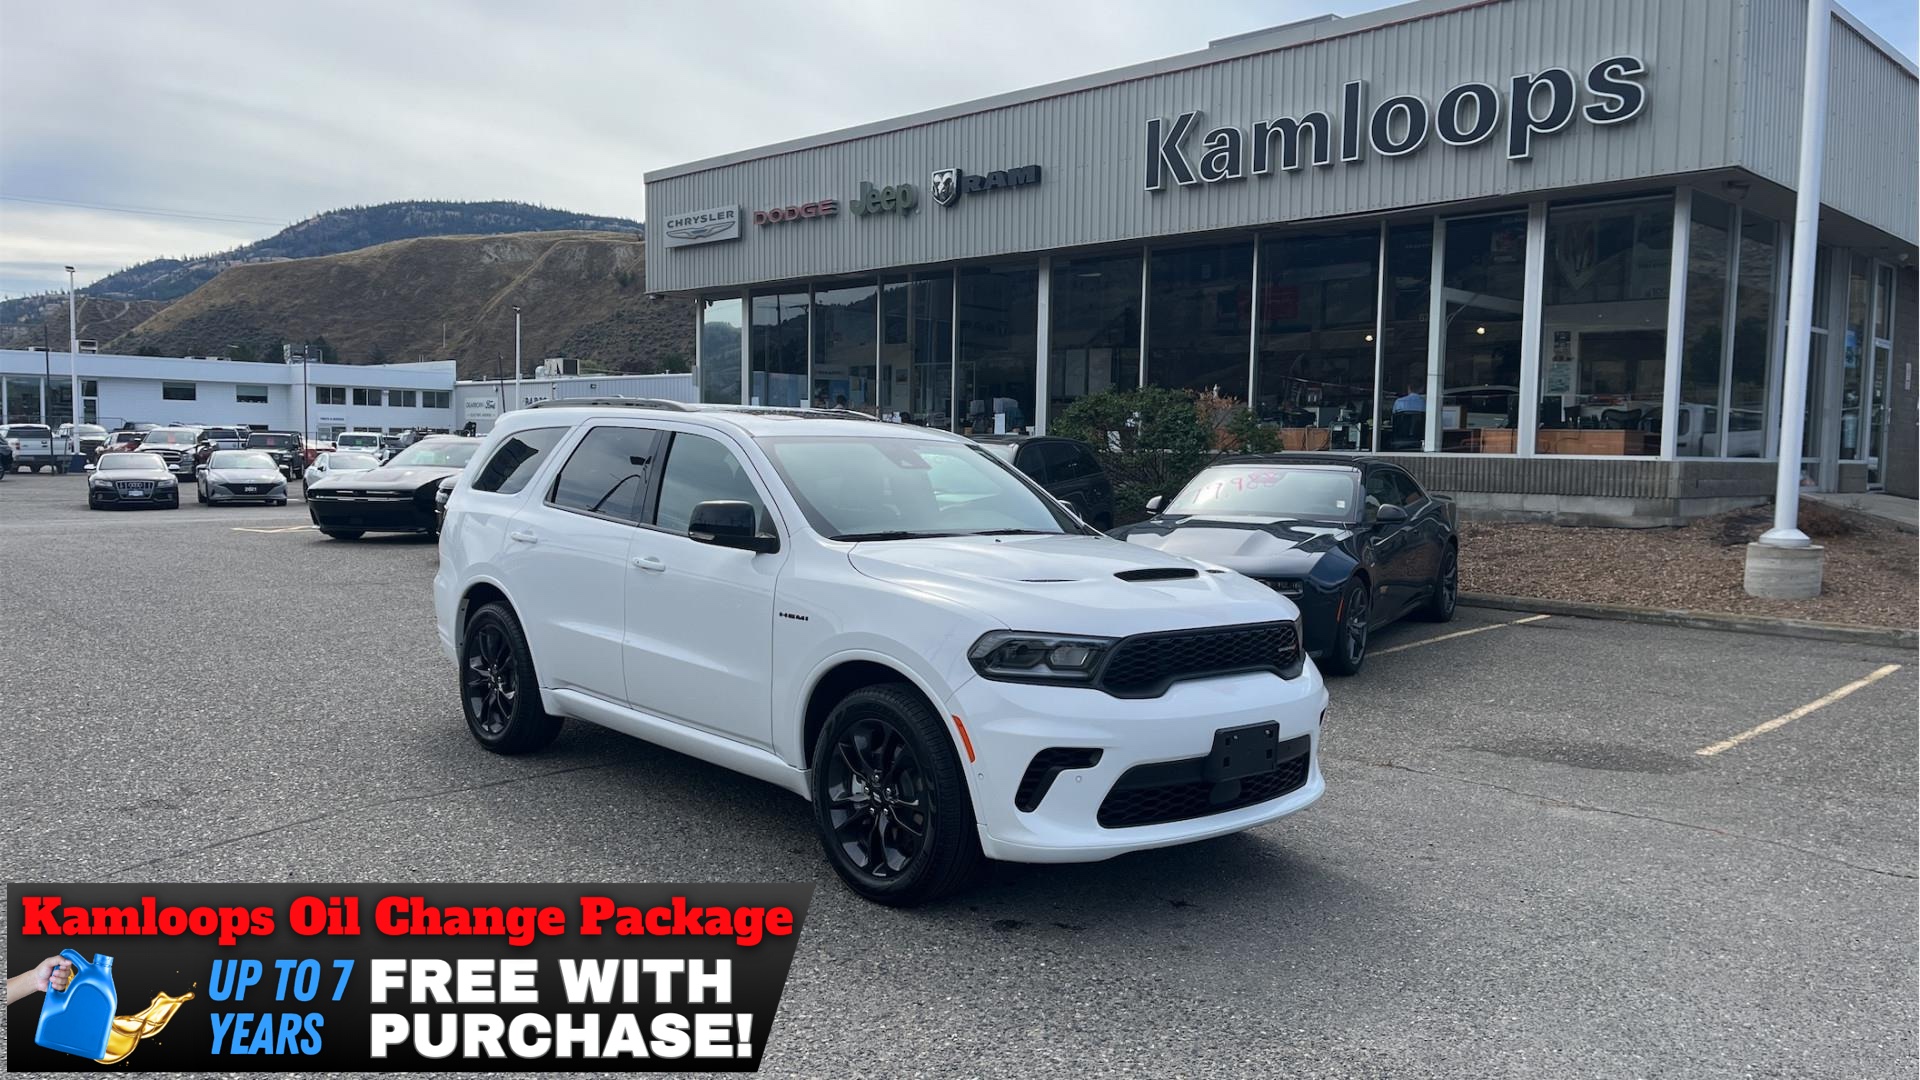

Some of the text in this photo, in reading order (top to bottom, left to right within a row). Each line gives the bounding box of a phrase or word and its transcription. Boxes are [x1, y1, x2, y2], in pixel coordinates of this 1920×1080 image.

[1144, 55, 1648, 193] Kamloops
[963, 165, 1042, 194] RAM
[752, 199, 838, 226] DODGE
[849, 181, 918, 217] Jeep
[666, 210, 735, 229] CHRYSLER
